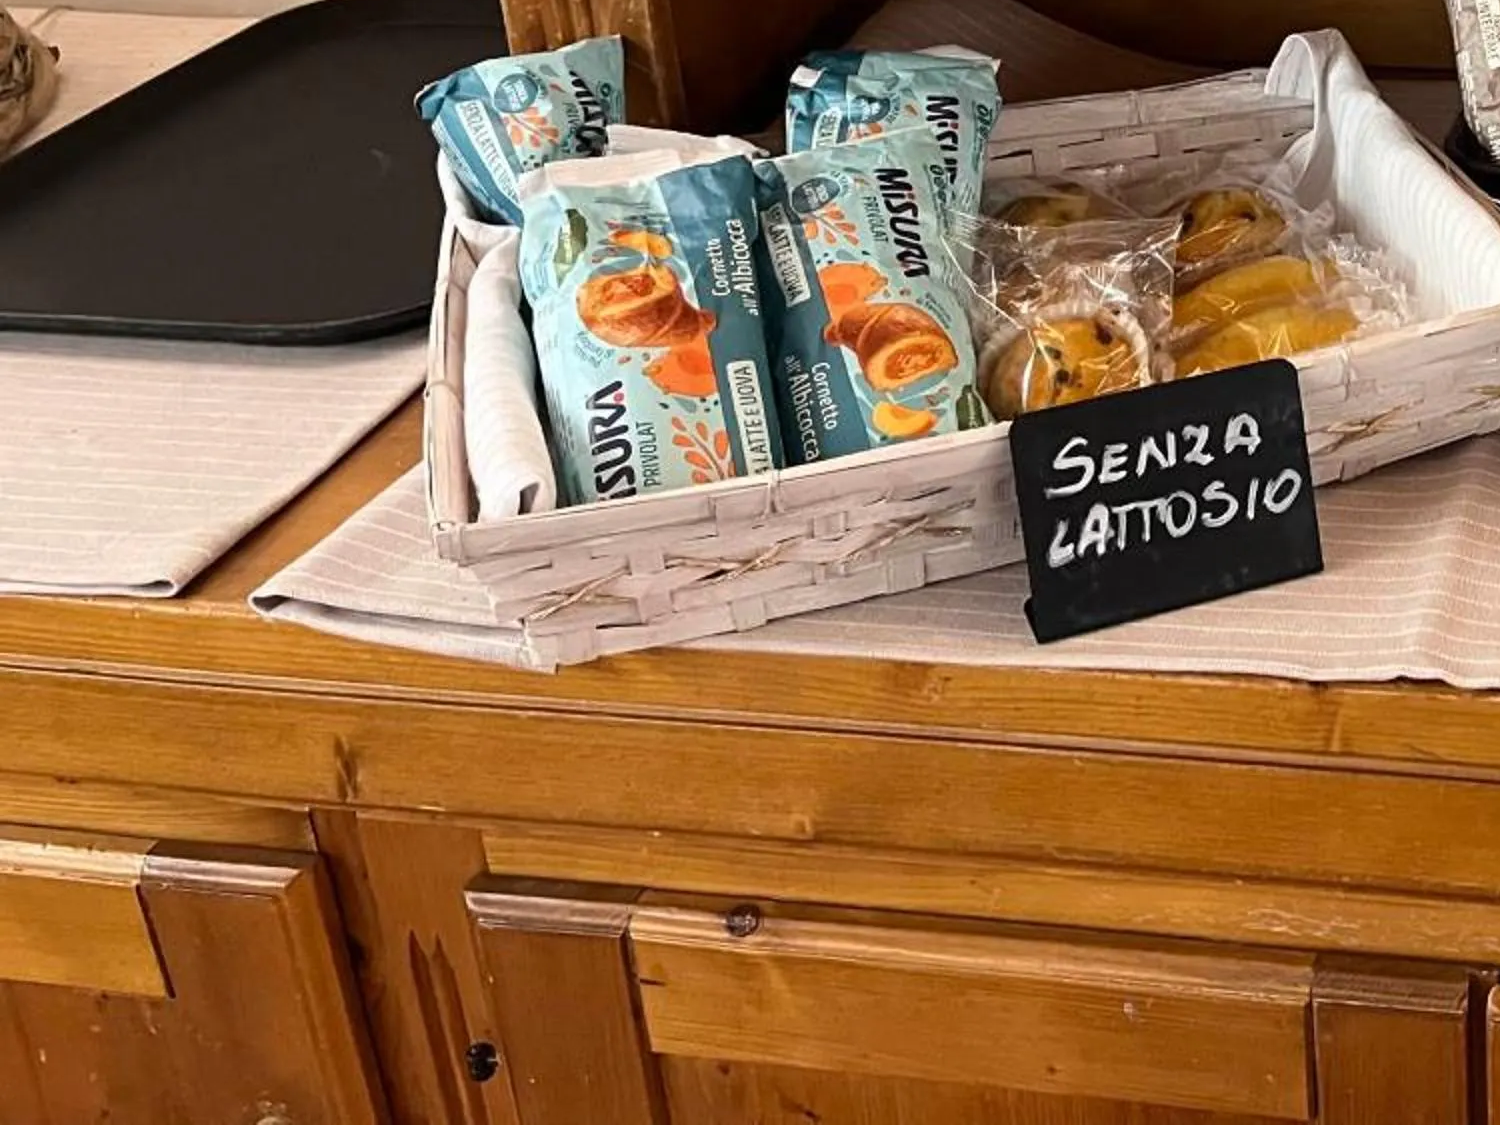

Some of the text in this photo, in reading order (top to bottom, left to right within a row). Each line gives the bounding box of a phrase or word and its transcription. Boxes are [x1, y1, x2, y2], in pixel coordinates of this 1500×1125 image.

[861, 195, 889, 244] PRIVOLAT
[705, 236, 732, 297] Cornetto
[733, 365, 757, 406] UOVA
[743, 407, 760, 417] E
[811, 362, 838, 430] Cornetto
[585, 379, 637, 501] iSURA
[635, 421, 661, 488] PRIVOLAT
[743, 419, 768, 463] LATTE
[1043, 411, 1262, 501] SENZA
[1046, 468, 1302, 569] LATTOSIO
